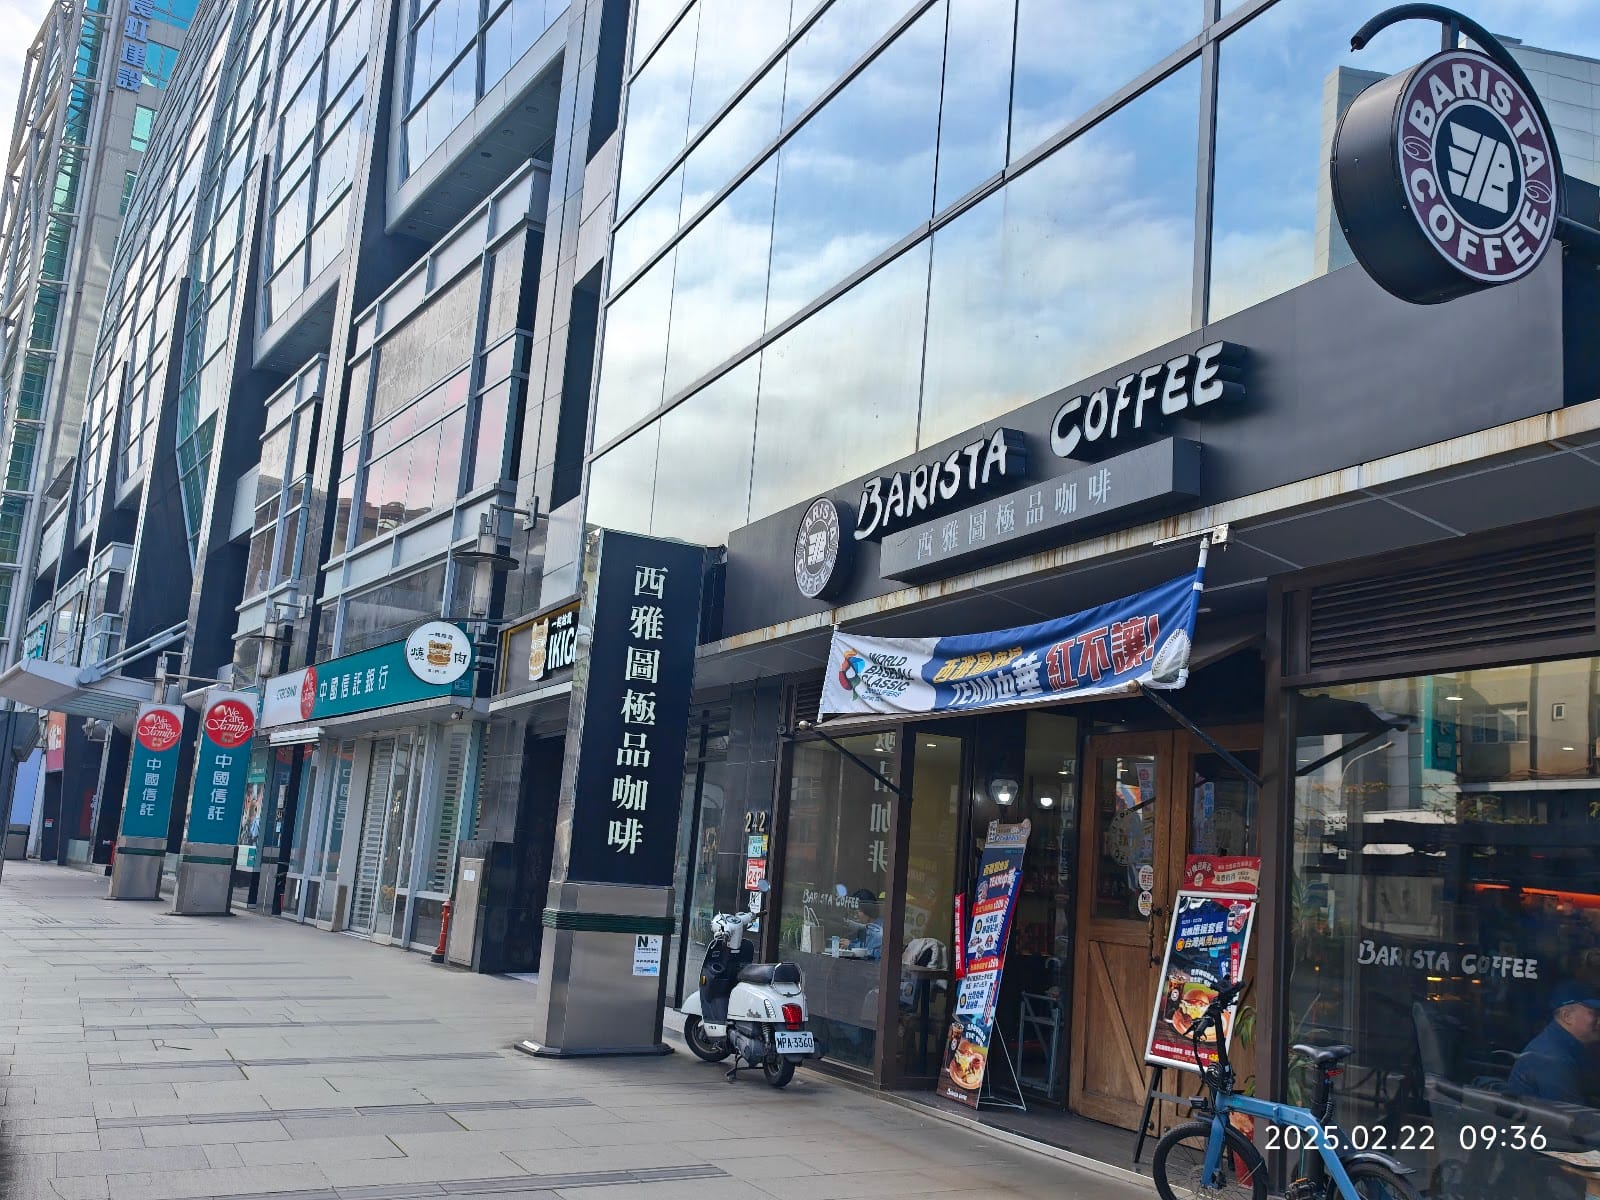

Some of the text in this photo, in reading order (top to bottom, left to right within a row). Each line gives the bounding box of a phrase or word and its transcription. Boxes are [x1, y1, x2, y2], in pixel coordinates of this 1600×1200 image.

[1408, 63, 1546, 177] BARISTA
[1410, 167, 1547, 271] COFFEE
[853, 340, 1224, 541] BARISTA COFFEE
[916, 469, 1112, 561] 西雅圖極品咖啡
[319, 664, 389, 703] 中國信託銀行
[861, 674, 910, 692] CLASSIC
[868, 652, 908, 667] WORLD
[222, 705, 240, 717] We
[607, 564, 669, 855] 西雅圖極品咖啡
[139, 758, 162, 817] 中國信託
[207, 753, 233, 821] 中國信託
[744, 811, 766, 833] 242
[1357, 939, 1539, 980] BARISTA COFFEE
